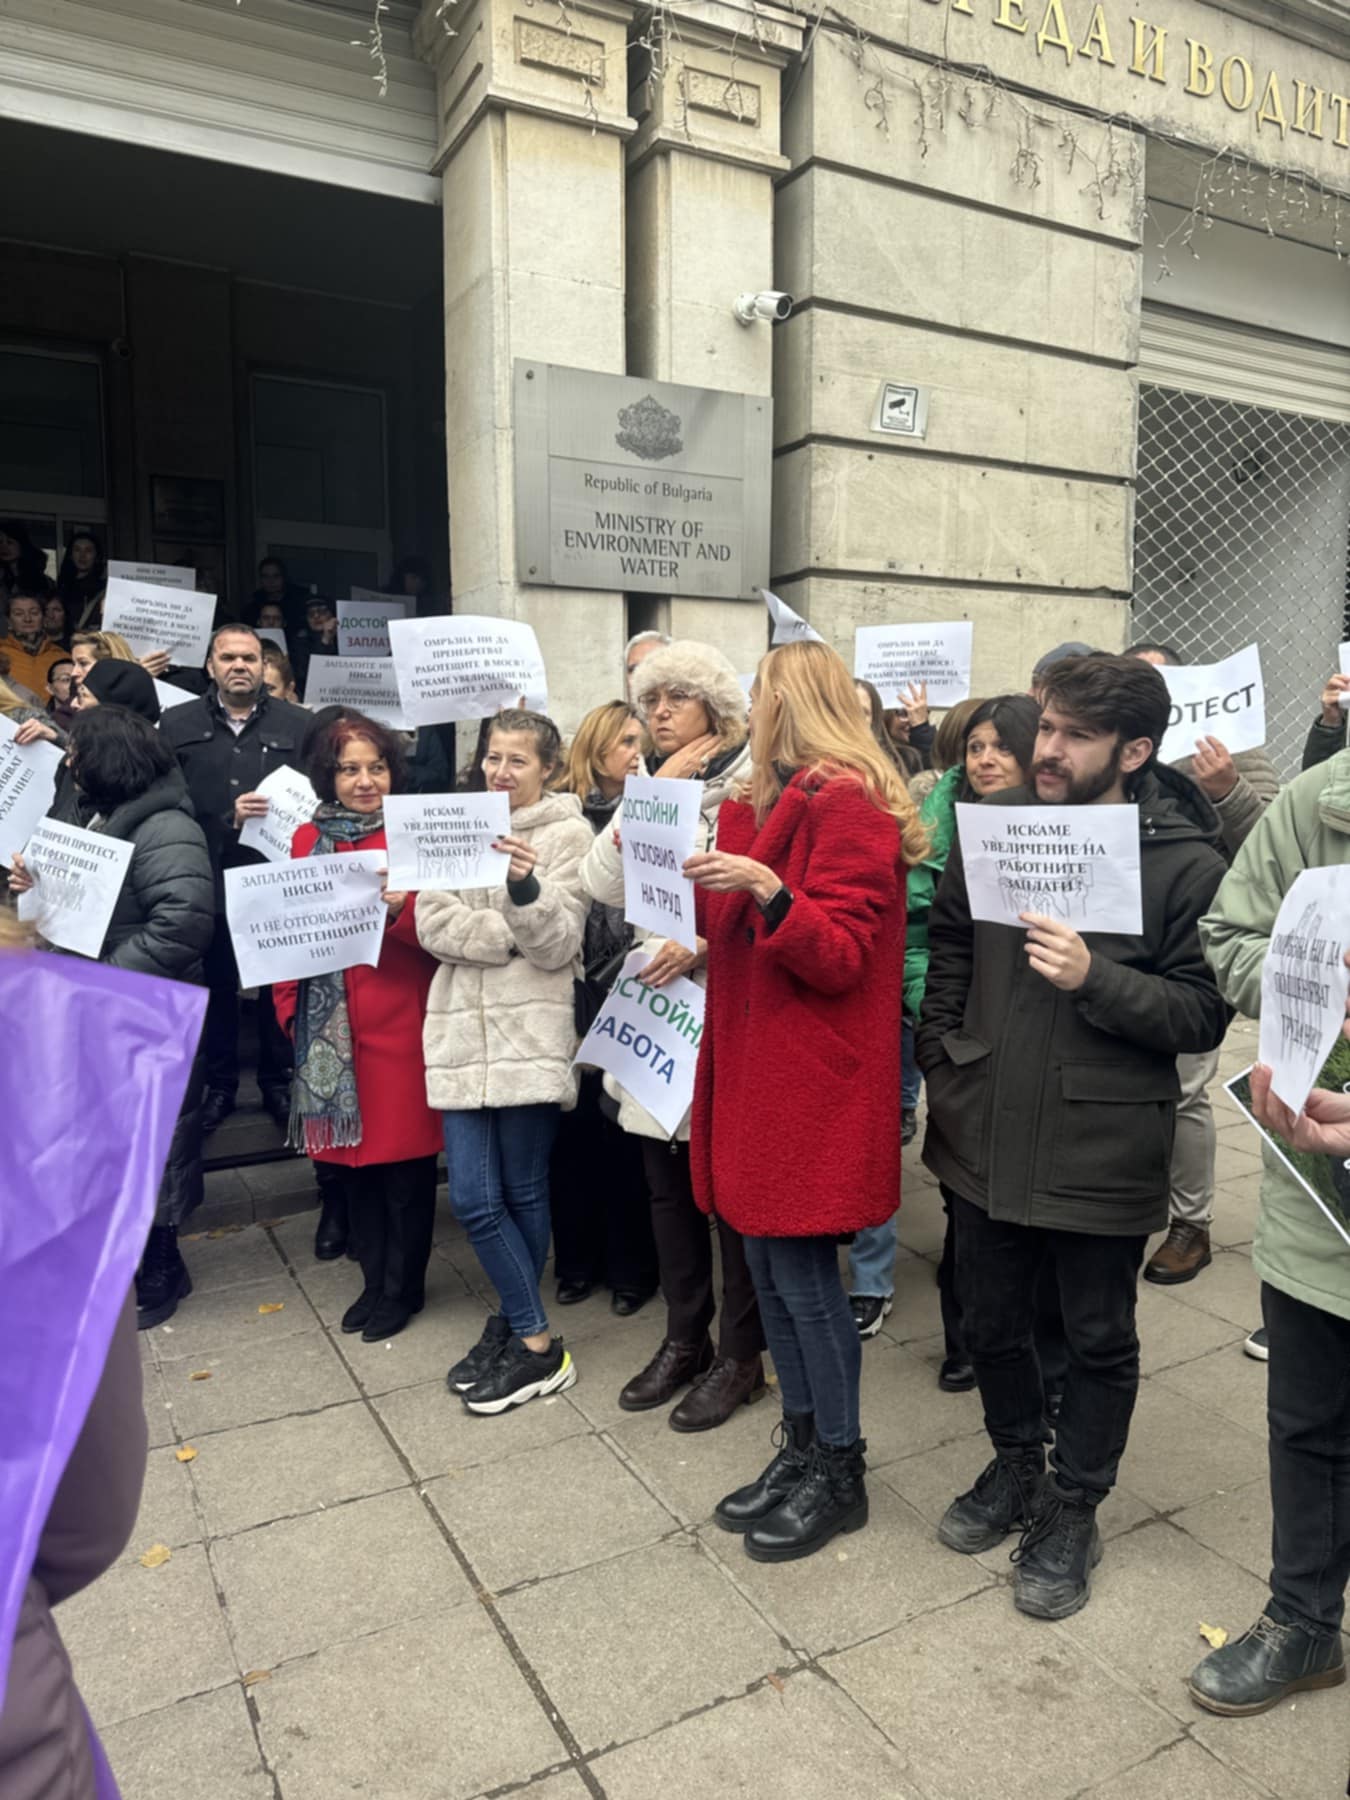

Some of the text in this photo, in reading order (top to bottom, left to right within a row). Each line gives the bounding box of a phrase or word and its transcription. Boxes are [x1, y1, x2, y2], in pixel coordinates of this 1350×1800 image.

[1128, 16, 1168, 85] И
[584, 473, 713, 503] Republic of Bulgaria
[595, 511, 703, 539] MINISTRY OF
[564, 529, 731, 562] ENVIRONMENT AND
[620, 556, 679, 578] WATER
[424, 635, 509, 647] ОМРЪЗНА НИ ДА
[432, 647, 502, 659] ПРЕНЕБРЕГВАТ
[415, 660, 480, 674] РАБОТЕЩИТЕ
[411, 676, 450, 688] ИСКАМЕ
[519, 672, 532, 680] НА
[421, 685, 477, 699] РАБОТНИТЕ
[423, 806, 466, 817] ИСКАМЕ
[622, 795, 678, 826] ДОСТОЙНИ
[403, 820, 489, 832] УВЕЛИЧЕНИЕ НА
[1006, 824, 1071, 837] ИСКАМЕ
[418, 834, 480, 845] РАБОТНИТЕ
[981, 840, 1106, 857] УВЕЛИЧЕНИЕ НА
[629, 840, 677, 872] УСЛОВИЯ
[241, 861, 366, 889] ЗАПЛАТИТЕ НИ СА
[999, 860, 1087, 875] РАБОТНИТЕ
[282, 880, 334, 898] НИСКИ
[641, 881, 683, 922] НА ТРУД
[250, 904, 380, 934] И НЕ ОТГОВАРЯТ НА
[257, 920, 379, 950] КОМПЕТЕНЦИИТЕ
[310, 946, 336, 960] НИ!
[611, 976, 703, 1048] СТОЙН
[592, 1016, 675, 1084] АБОТА
